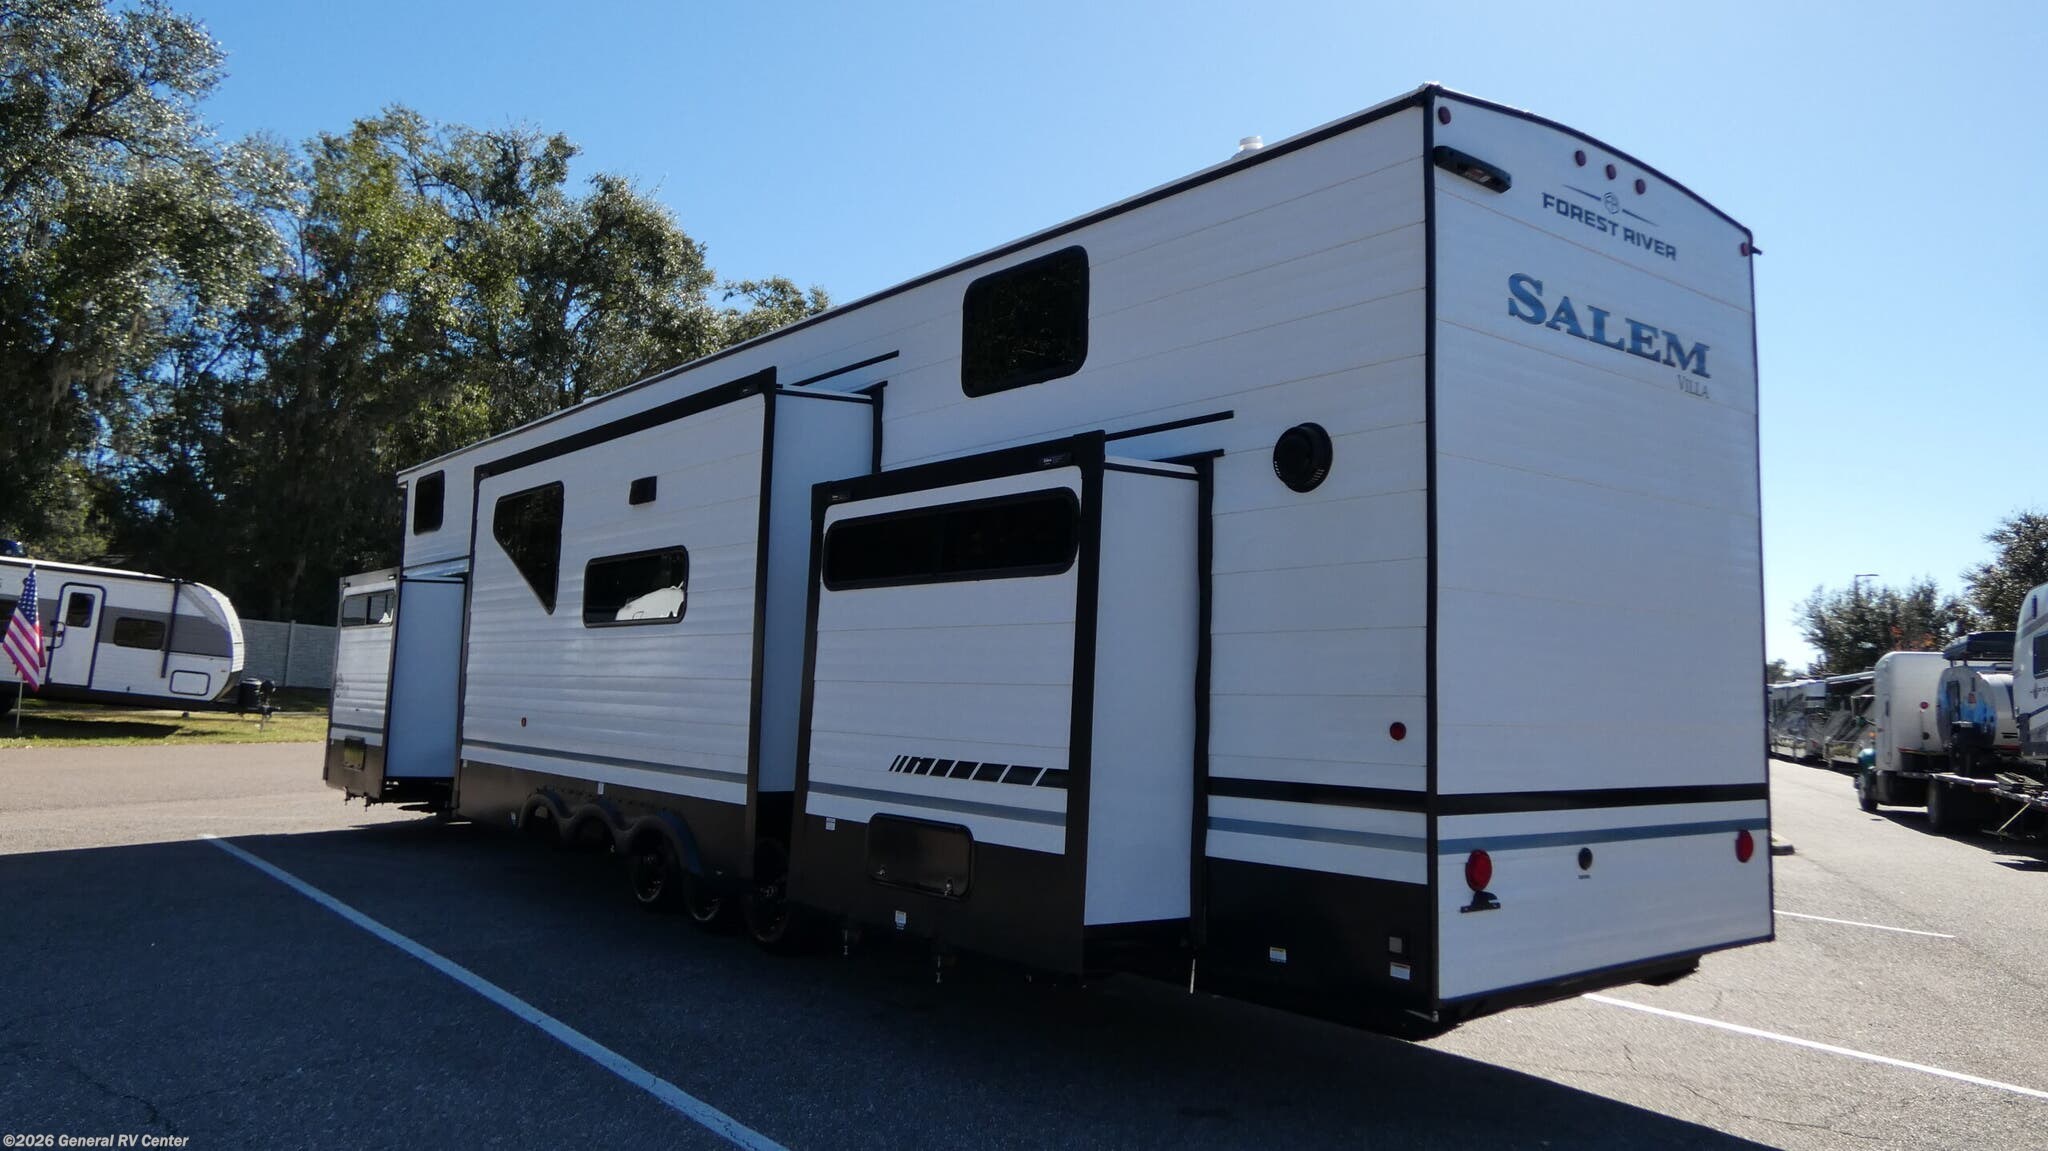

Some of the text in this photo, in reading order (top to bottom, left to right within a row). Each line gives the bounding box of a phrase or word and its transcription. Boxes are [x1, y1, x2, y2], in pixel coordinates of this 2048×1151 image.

[1542, 192, 1676, 260] FOREST RIVER
[1508, 273, 1711, 378] SALEM
[1678, 374, 1710, 399] VILLA
